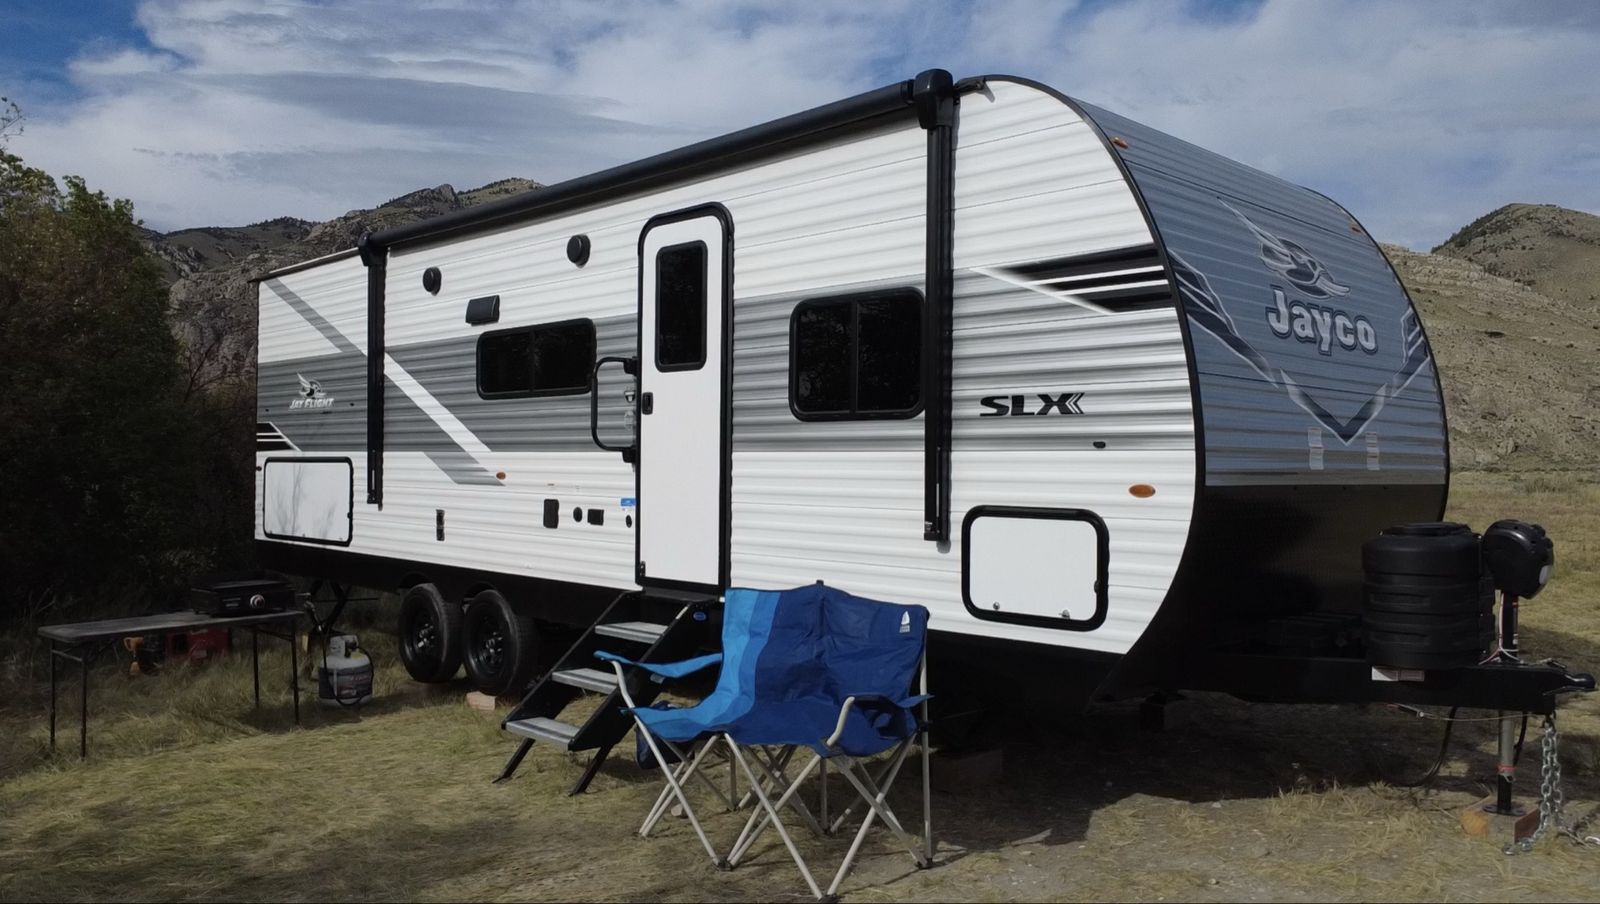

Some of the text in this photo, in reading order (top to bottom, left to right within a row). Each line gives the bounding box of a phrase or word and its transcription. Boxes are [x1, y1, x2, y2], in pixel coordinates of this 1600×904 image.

[1266, 285, 1378, 356] Jayco
[304, 398, 334, 409] FLIGHT
[980, 392, 1085, 416] SLX
